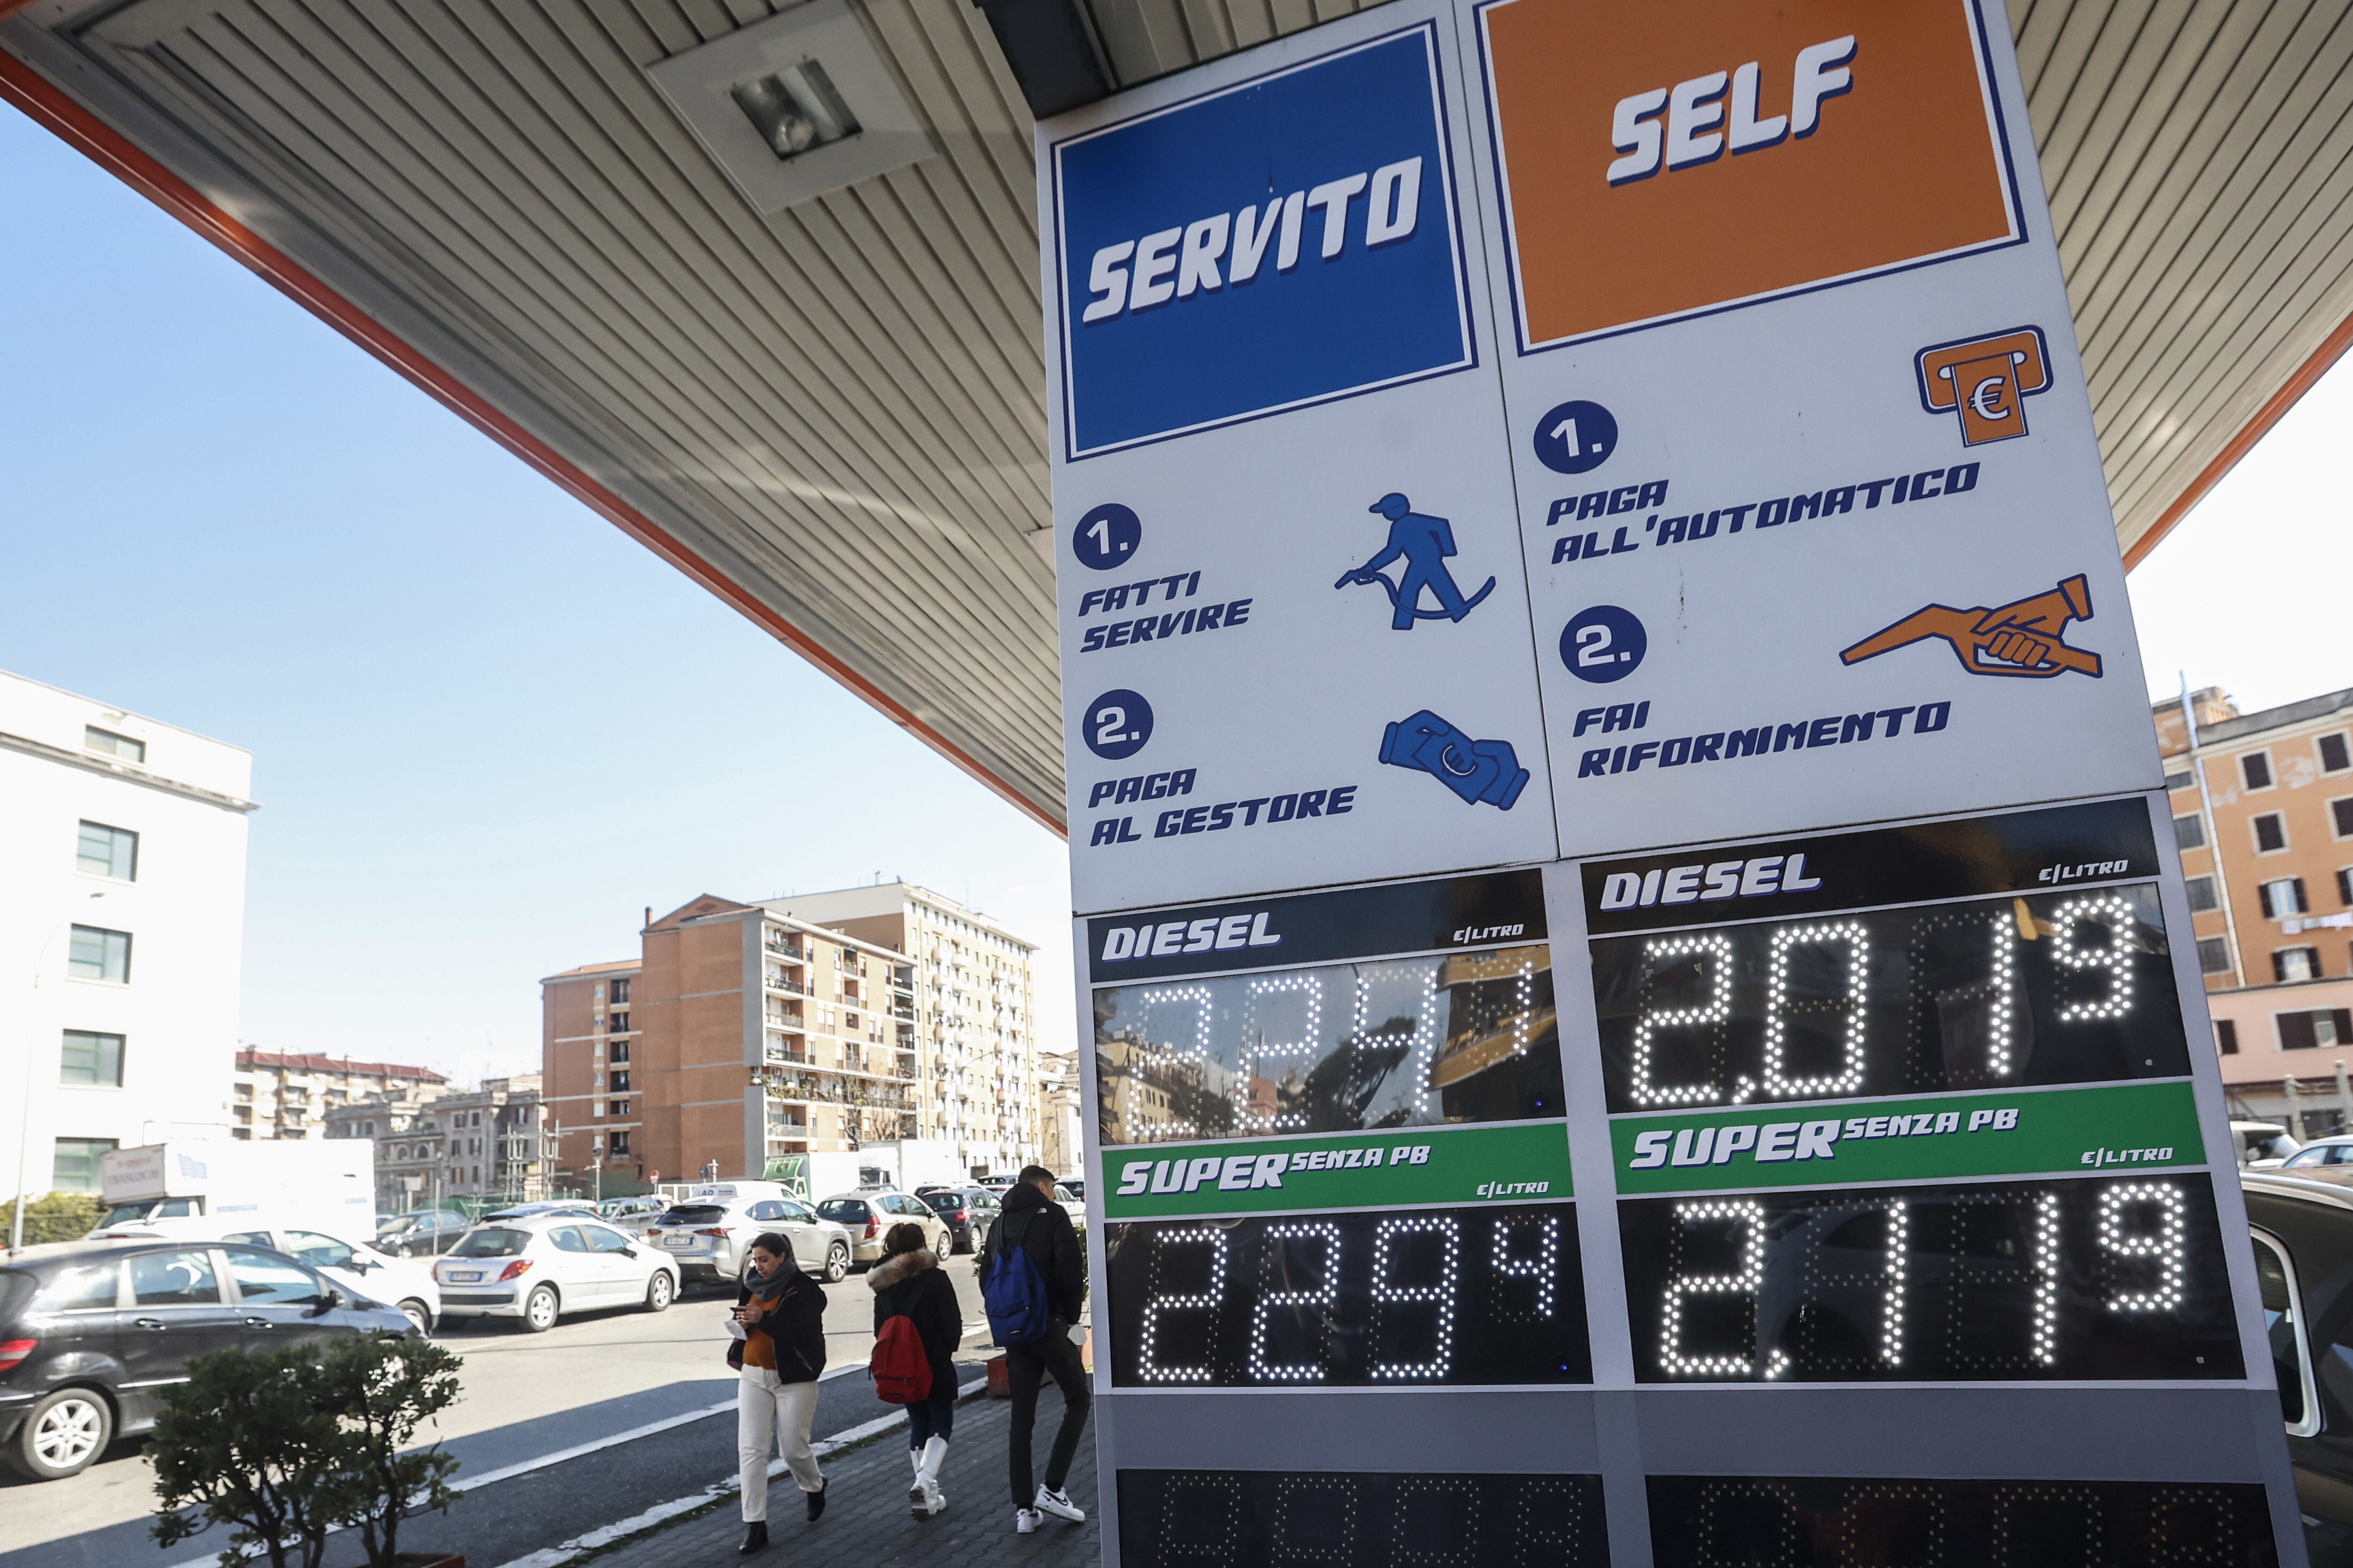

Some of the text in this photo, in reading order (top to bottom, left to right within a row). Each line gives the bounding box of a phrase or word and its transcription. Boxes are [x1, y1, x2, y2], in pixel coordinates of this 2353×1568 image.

[1606, 35, 1857, 187] SELF
[1083, 156, 1422, 325] SERVITO
[1549, 418, 1603, 458] 1.
[1546, 479, 1669, 527] PAGA
[1551, 461, 1980, 565] ALL'AUTOMATICO
[1086, 520, 1128, 555] 1.
[1078, 570, 1202, 617] FATTI
[1080, 598, 1254, 653] SERVIRE
[1576, 624, 1631, 666] 2.
[1096, 707, 1140, 745] 2.
[1573, 700, 1650, 737] FAI
[1578, 701, 1951, 778] RIFORNIMENTO
[1088, 768, 1197, 808] PAGA
[1090, 785, 1358, 847] AL GESTORE
[1600, 853, 1823, 912] DIESEL
[1101, 912, 1282, 961] DIESEL
[1629, 1109, 2019, 1171] SUPER SENZA PB
[1116, 1145, 1432, 1198] SUPER SENZA PB
